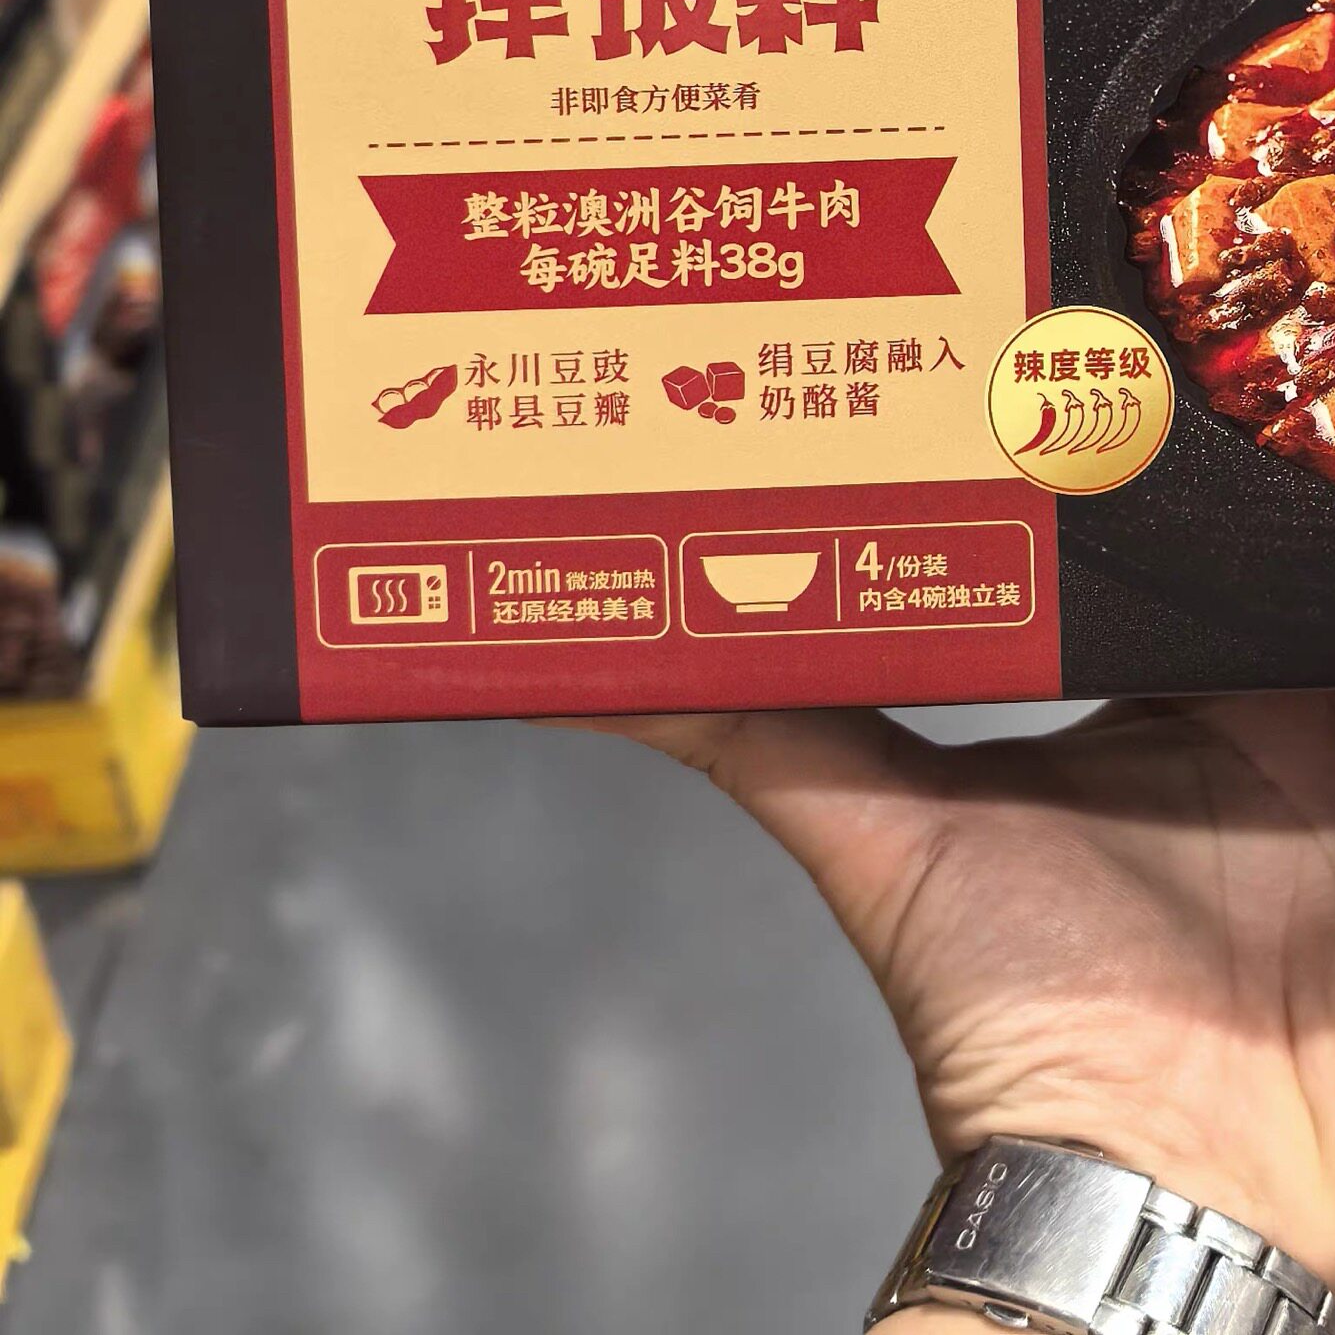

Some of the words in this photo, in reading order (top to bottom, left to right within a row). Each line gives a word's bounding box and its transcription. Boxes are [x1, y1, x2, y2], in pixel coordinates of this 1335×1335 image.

[550, 82, 760, 116] 非即食方便菜肴
[461, 179, 861, 241] 整粒澳洲谷饲牛肉
[520, 239, 805, 294] 每碗足料38g
[464, 348, 630, 387] 永川豆豉
[758, 335, 966, 378] 绢豆腐融入
[1013, 347, 1152, 383] 辣度等级
[466, 390, 631, 431] 郫县豆瓣
[758, 381, 881, 422] 奶酪酱
[488, 560, 561, 595] 2min
[565, 568, 656, 592] 微波加热
[859, 582, 1021, 612] 内含4碗独立装
[492, 596, 655, 625] 还原经典美食
[956, 1162, 1008, 1250] CASIO
